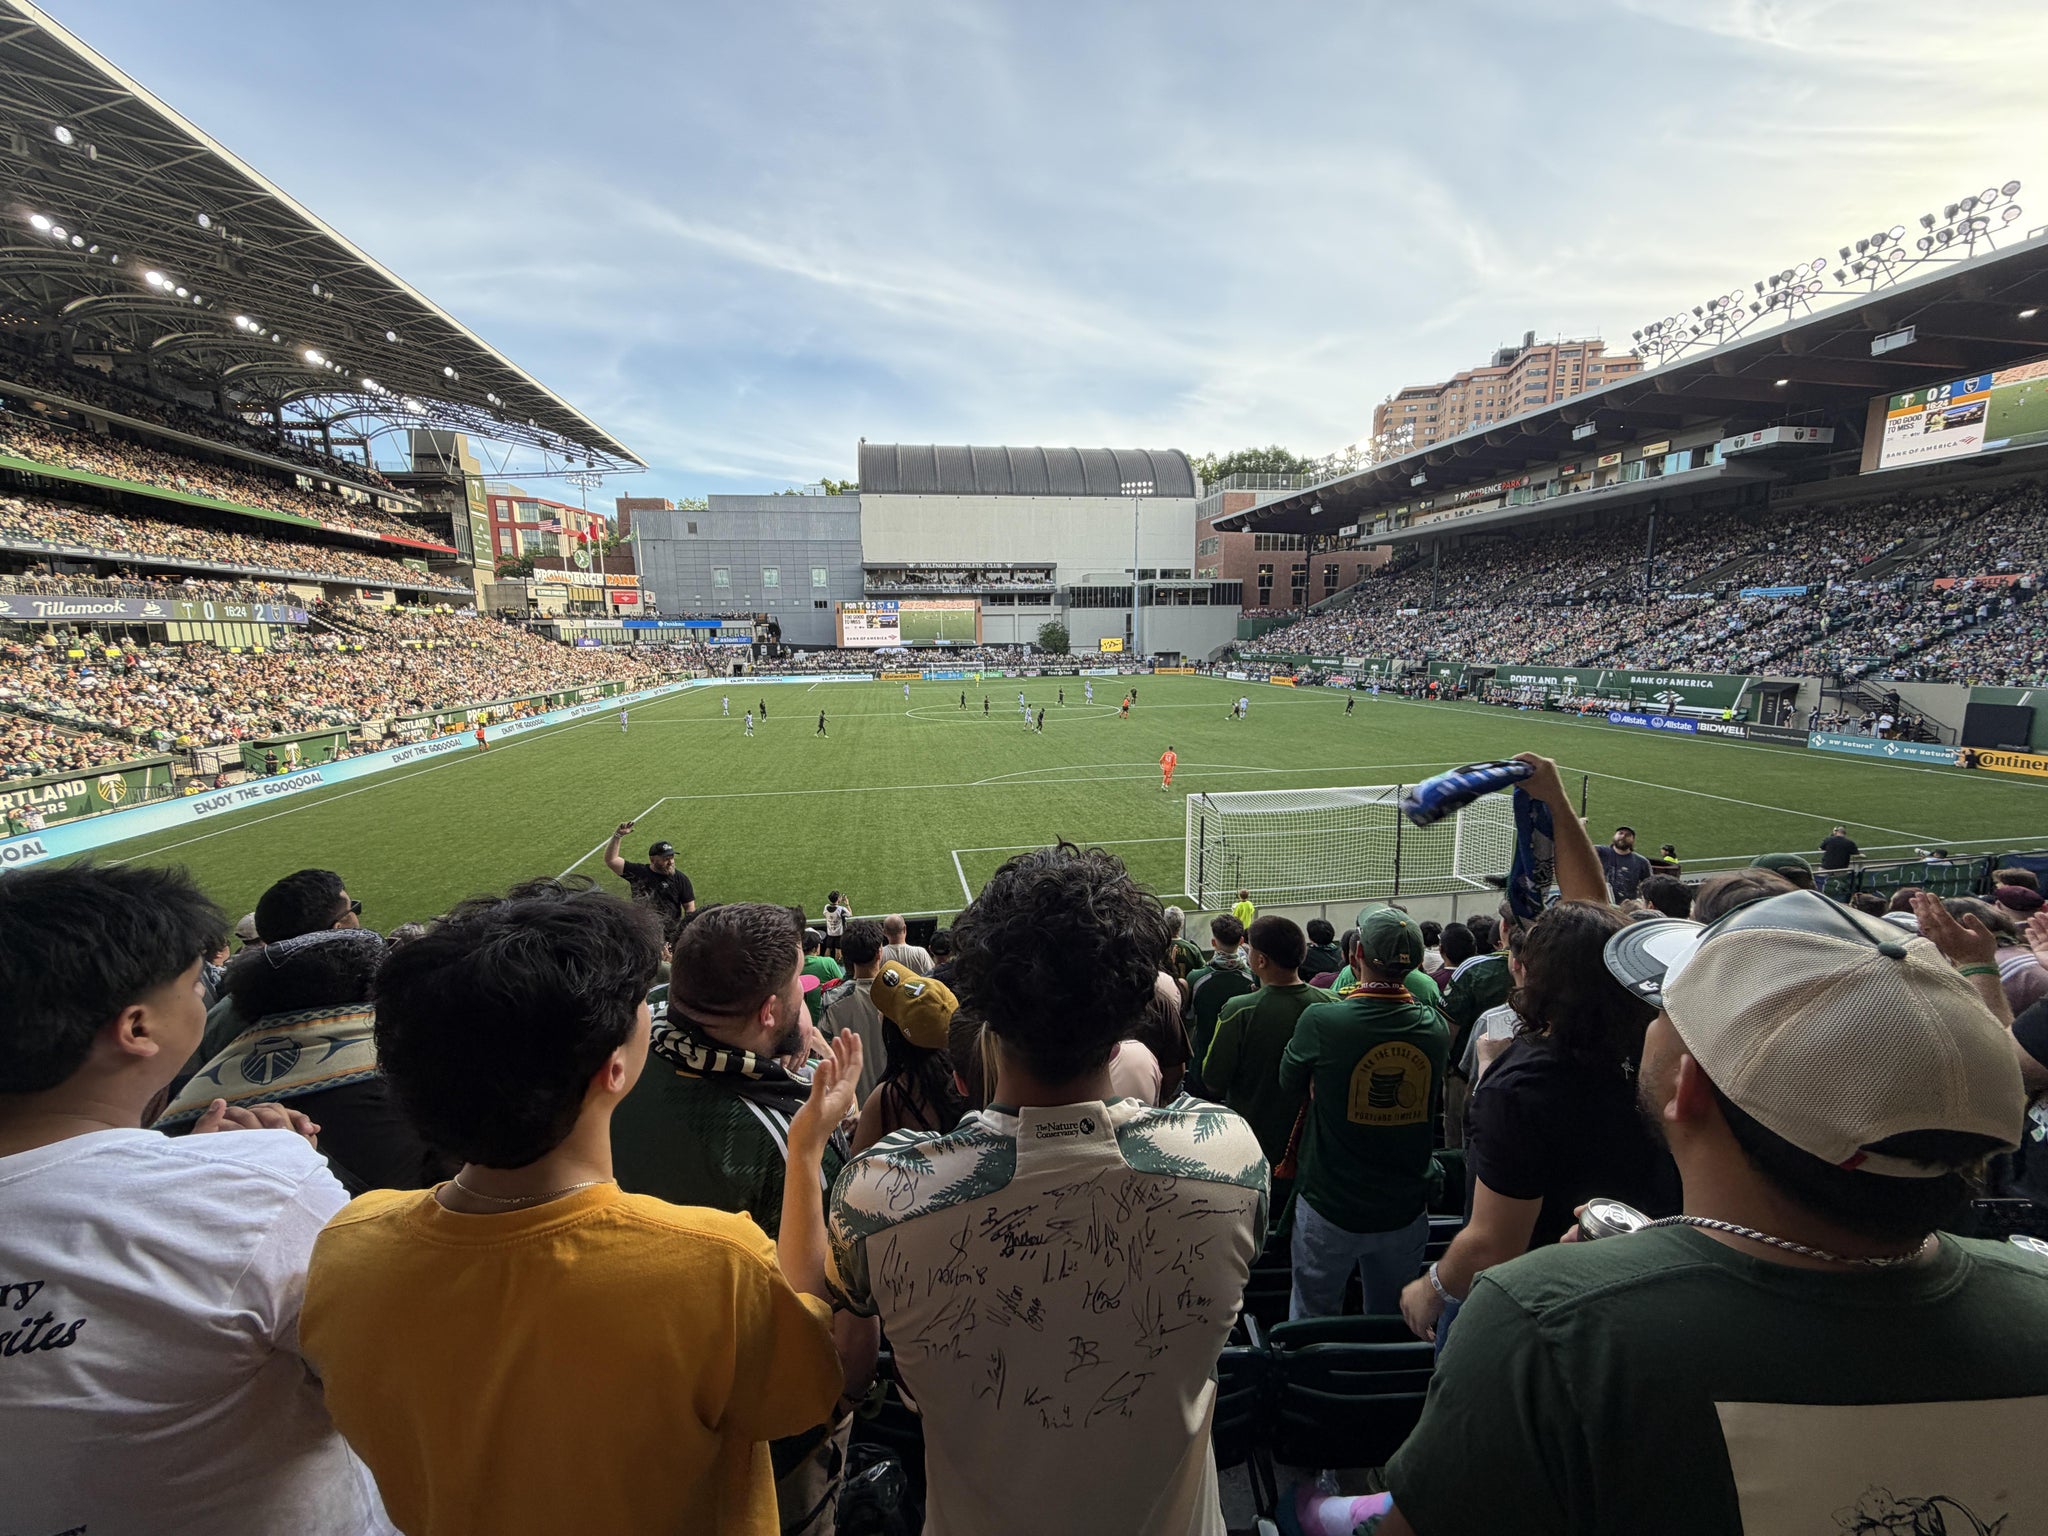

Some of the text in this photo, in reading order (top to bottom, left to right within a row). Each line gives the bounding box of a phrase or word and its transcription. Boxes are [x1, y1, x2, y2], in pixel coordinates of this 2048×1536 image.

[1926, 384, 1952, 402] 0 2
[1925, 399, 1949, 411] 16:24
[1903, 413, 1923, 424] GOOD
[1887, 422, 1915, 434] TO MISS
[1886, 440, 1958, 459] BANK OF AMERICA
[1460, 480, 1521, 500] PROVIDENCE PARK
[533, 568, 640, 587] PROVIDENCE PARK
[32, 600, 128, 617] Tillamook
[203, 600, 215, 621] 0
[254, 603, 265, 621] 2
[1510, 674, 1558, 685] PORTLAND
[1630, 676, 1714, 689] BANK OF AMERICA
[1621, 714, 1648, 726] Allstate
[1663, 720, 1694, 731] Allstate
[414, 745, 428, 756] THE
[1842, 740, 1872, 749] Natural
[1920, 749, 1954, 759] Natural
[193, 792, 234, 815] ENJOY
[236, 786, 262, 801] THE
[1048, 1121, 1079, 1132] Nature
[1036, 1129, 1079, 1139] Conservancy
